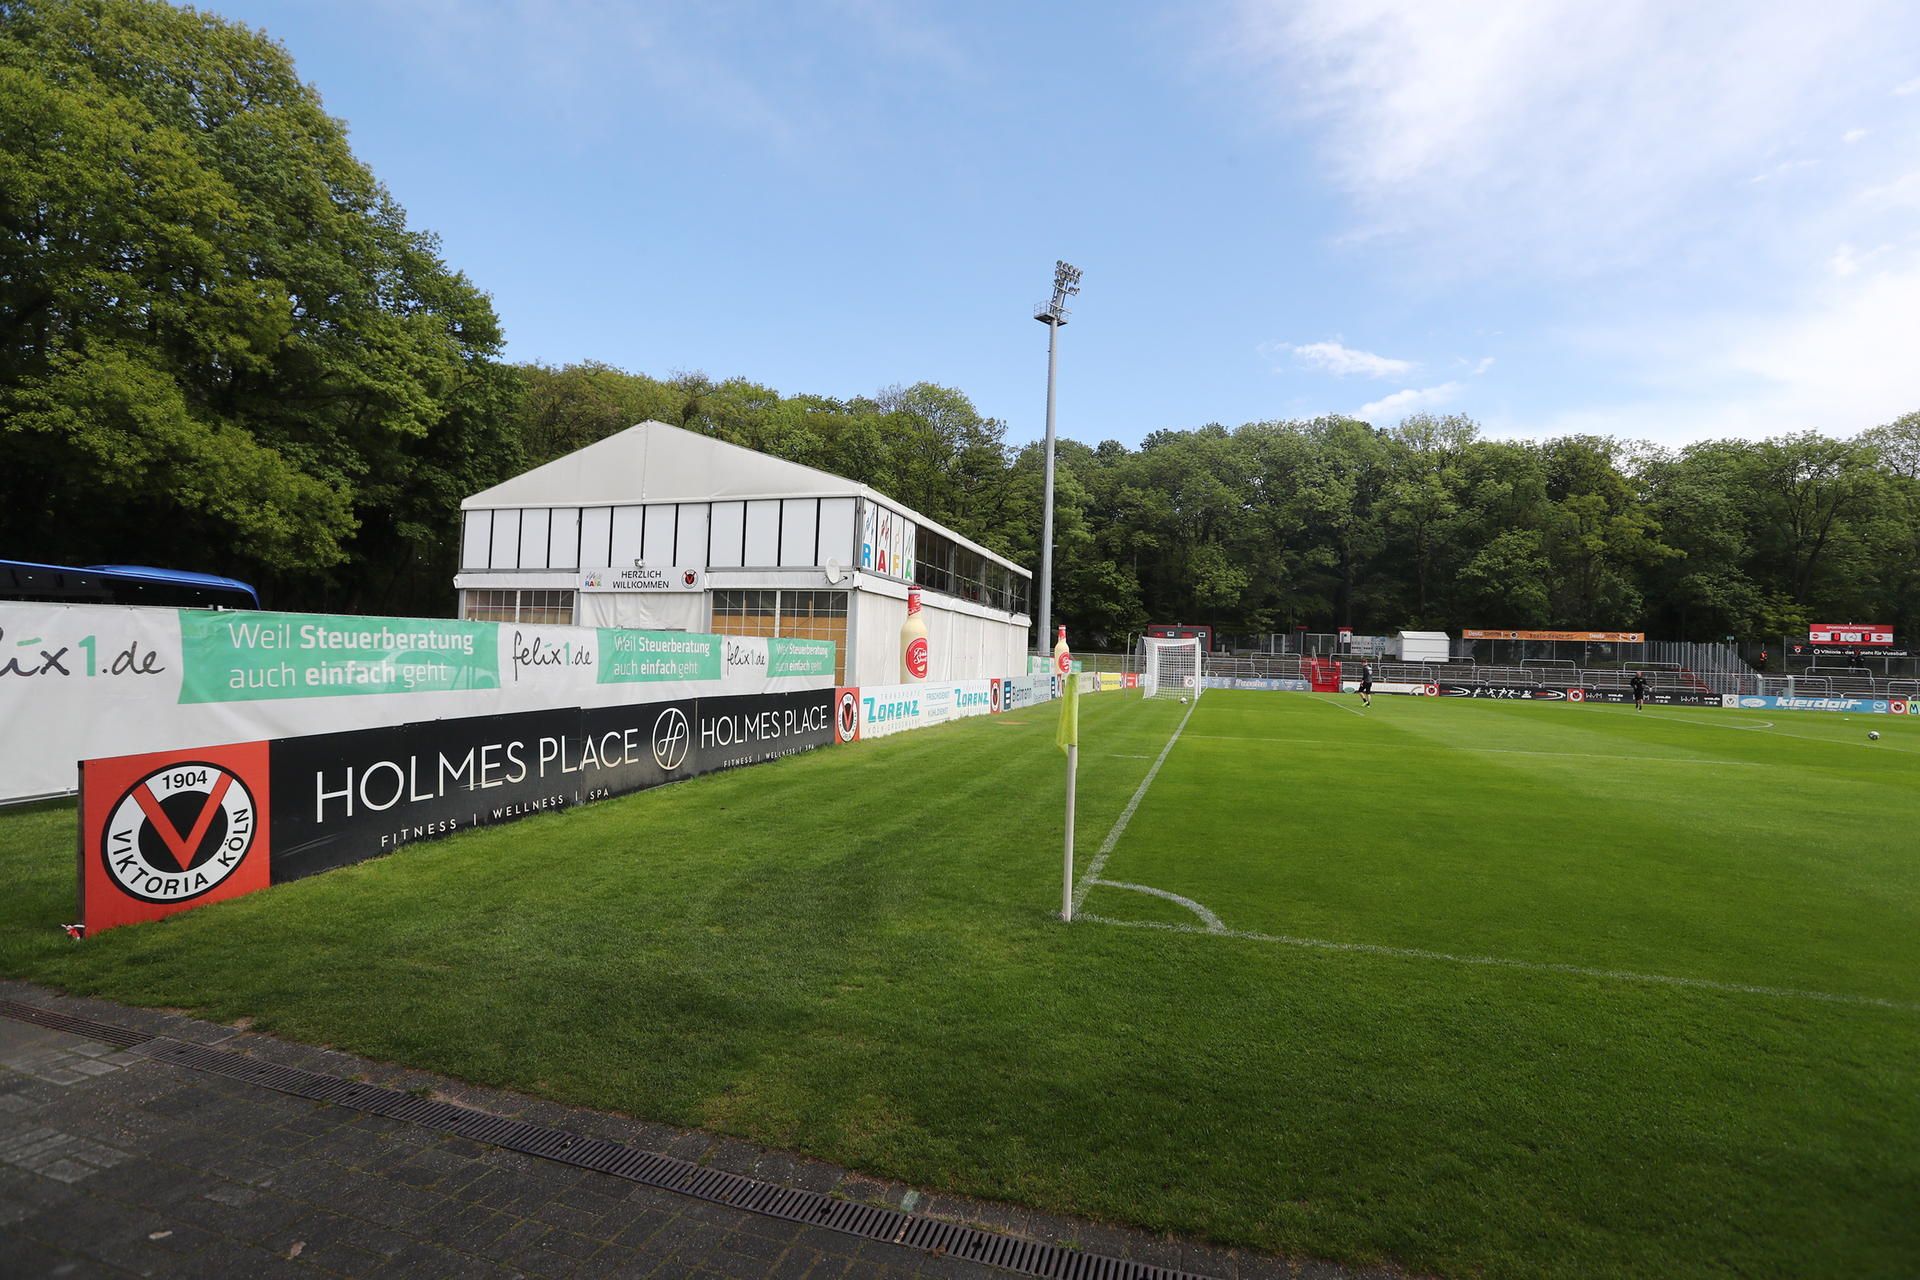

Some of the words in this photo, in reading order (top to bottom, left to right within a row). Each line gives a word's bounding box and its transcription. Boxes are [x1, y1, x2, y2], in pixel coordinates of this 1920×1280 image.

[612, 580, 670, 589] WILLKOMMEN
[621, 570, 662, 579] HERZLICH
[0, 625, 165, 678] ix1.de
[229, 622, 291, 650] Weil
[299, 625, 475, 656] Steuerberatung
[613, 634, 636, 652] Weil
[638, 636, 711, 657] Steuerberatung
[788, 642, 829, 659] Steuerberatung
[512, 629, 593, 682] felix1.de
[613, 659, 638, 676] auch
[640, 658, 677, 675] einfach
[678, 661, 699, 677] geht
[229, 661, 296, 690] auch
[305, 659, 396, 686] einfach
[402, 662, 448, 689] geht
[1775, 696, 1862, 710] kierdorf
[701, 711, 780, 749] HOLMES
[784, 704, 828, 735] PLACE
[723, 755, 753, 768] FITNESS
[765, 747, 797, 759] WELLNESS
[162, 769, 209, 791] 1904
[316, 740, 527, 824] HOLMES
[538, 727, 639, 779] PLACE
[380, 818, 458, 848] FITNESS
[492, 793, 565, 820] WELLNESS
[589, 787, 610, 801] SPA
[216, 807, 249, 869] KÖLN
[112, 828, 210, 897] VIKTORIA
